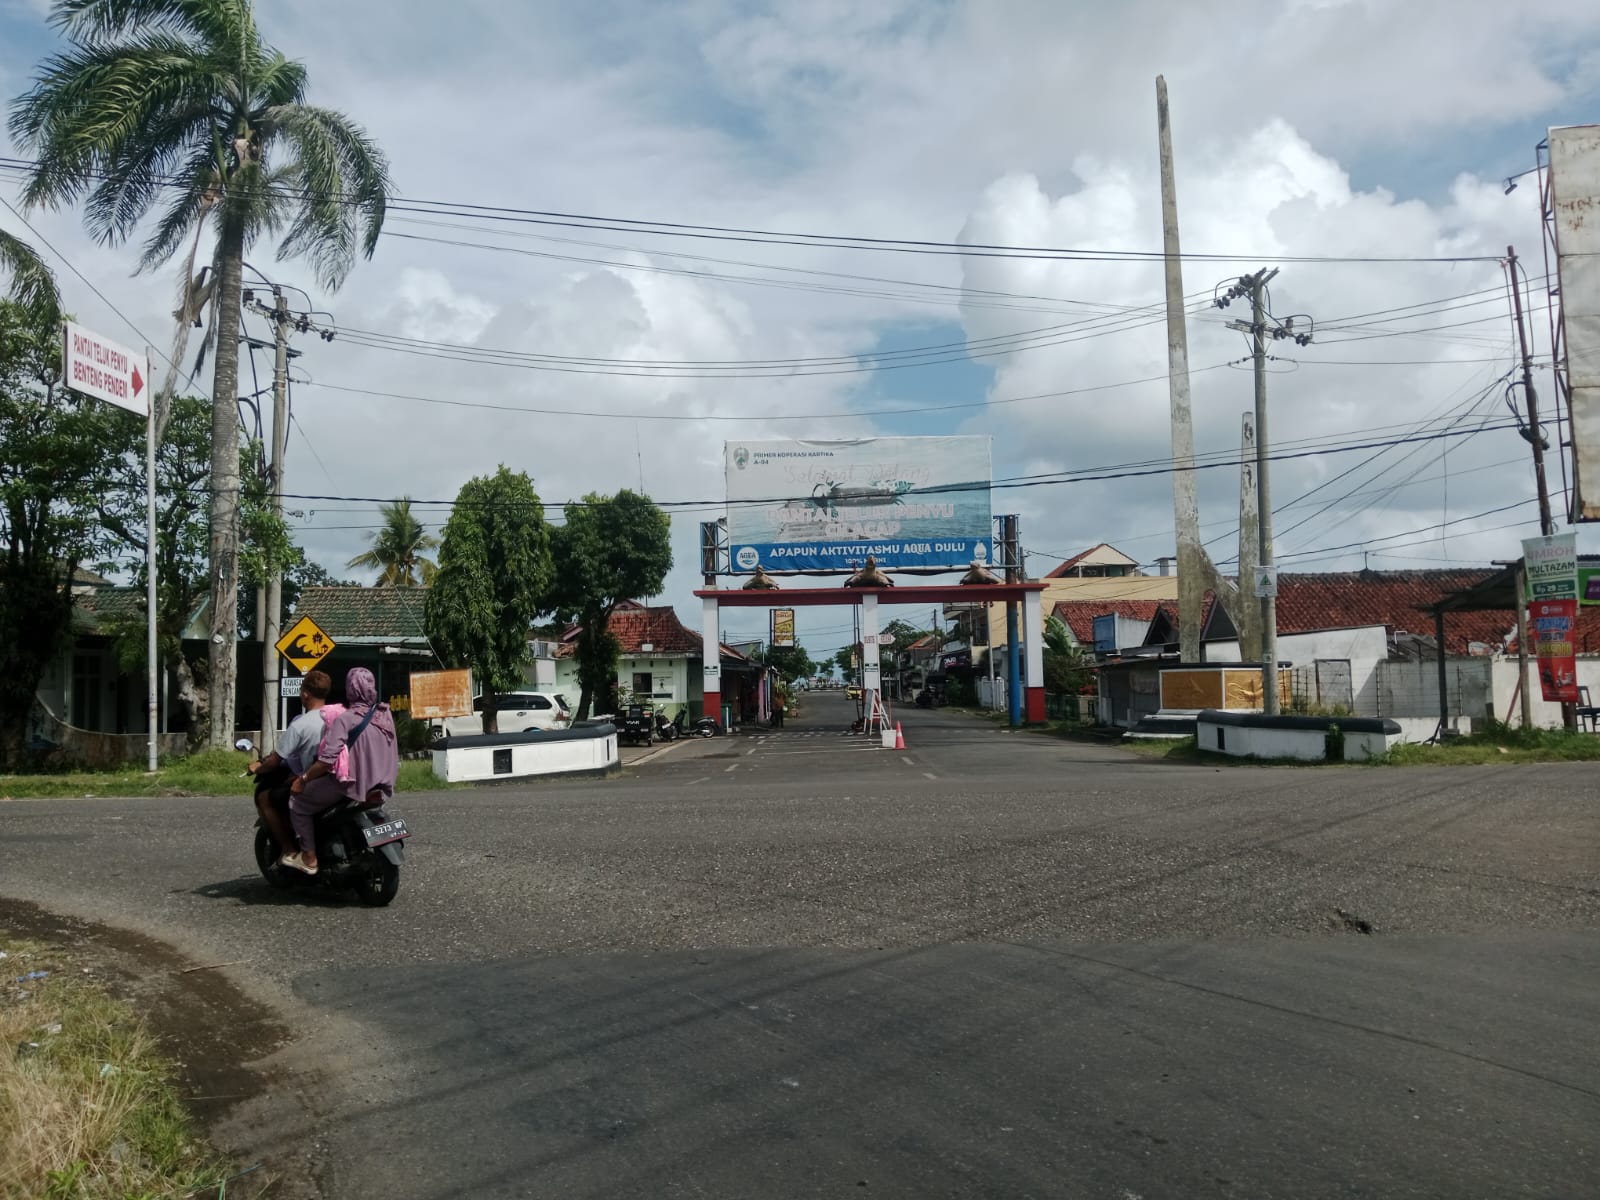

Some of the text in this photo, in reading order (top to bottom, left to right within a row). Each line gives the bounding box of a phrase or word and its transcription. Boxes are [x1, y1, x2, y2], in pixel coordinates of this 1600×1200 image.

[74, 333, 127, 374] PANTAI TELUK PENYU
[74, 360, 127, 399] BENTENG PENDEM
[769, 542, 966, 558] APAPUN AKTIVITASMU AQUA DULU
[1526, 546, 1574, 560] UMROH
[1528, 561, 1575, 574] MULTAZAM
